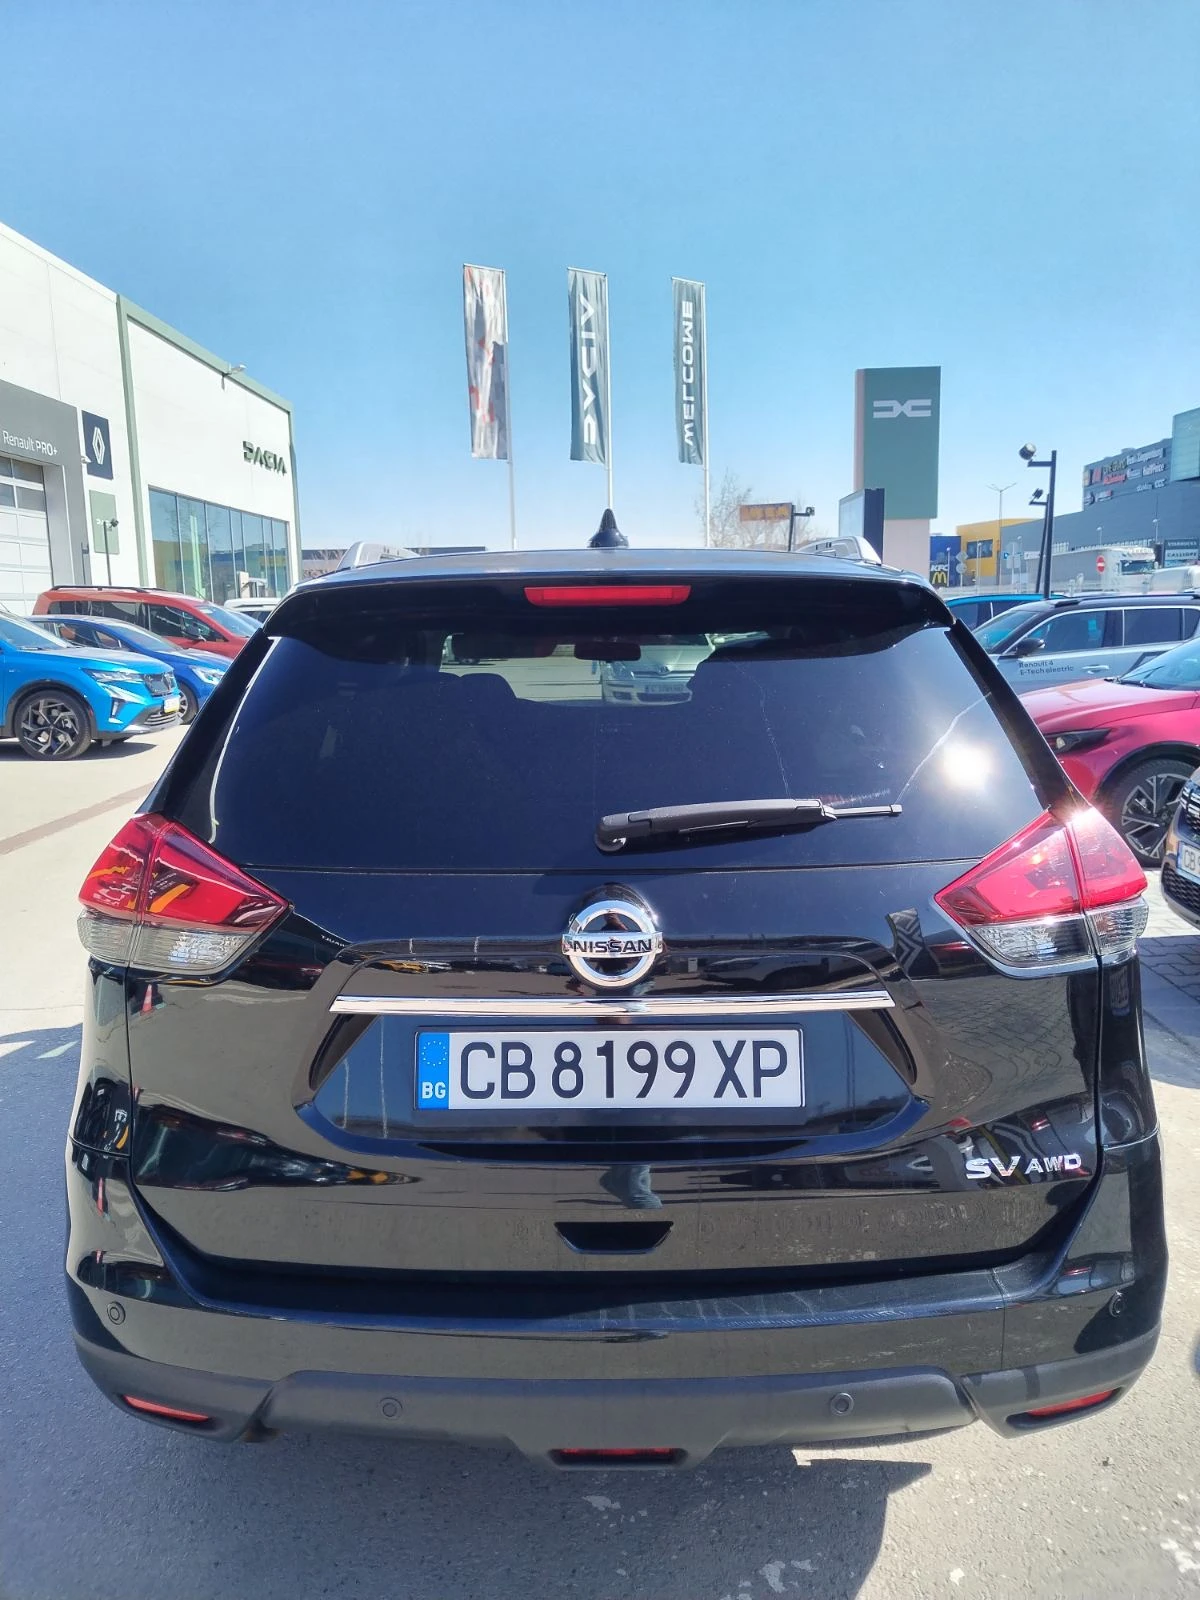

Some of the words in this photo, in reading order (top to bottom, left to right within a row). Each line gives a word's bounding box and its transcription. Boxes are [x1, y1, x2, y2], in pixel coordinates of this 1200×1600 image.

[579, 293, 597, 446] DACIA
[682, 300, 695, 447] WELCOME
[2, 430, 35, 452] Renault
[35, 440, 58, 456] PRO+
[242, 441, 287, 475] DACIA
[930, 564, 948, 572] KFC
[1019, 668, 1045, 676] E-Tech
[1045, 665, 1074, 674] electric
[572, 939, 653, 954] NISSAN
[421, 1081, 446, 1099] BG
[460, 1041, 536, 1100] CB
[551, 1041, 697, 1099] 8199
[713, 1041, 788, 1099] XP
[965, 1155, 1021, 1180] SV
[1024, 1153, 1082, 1175] AWD
